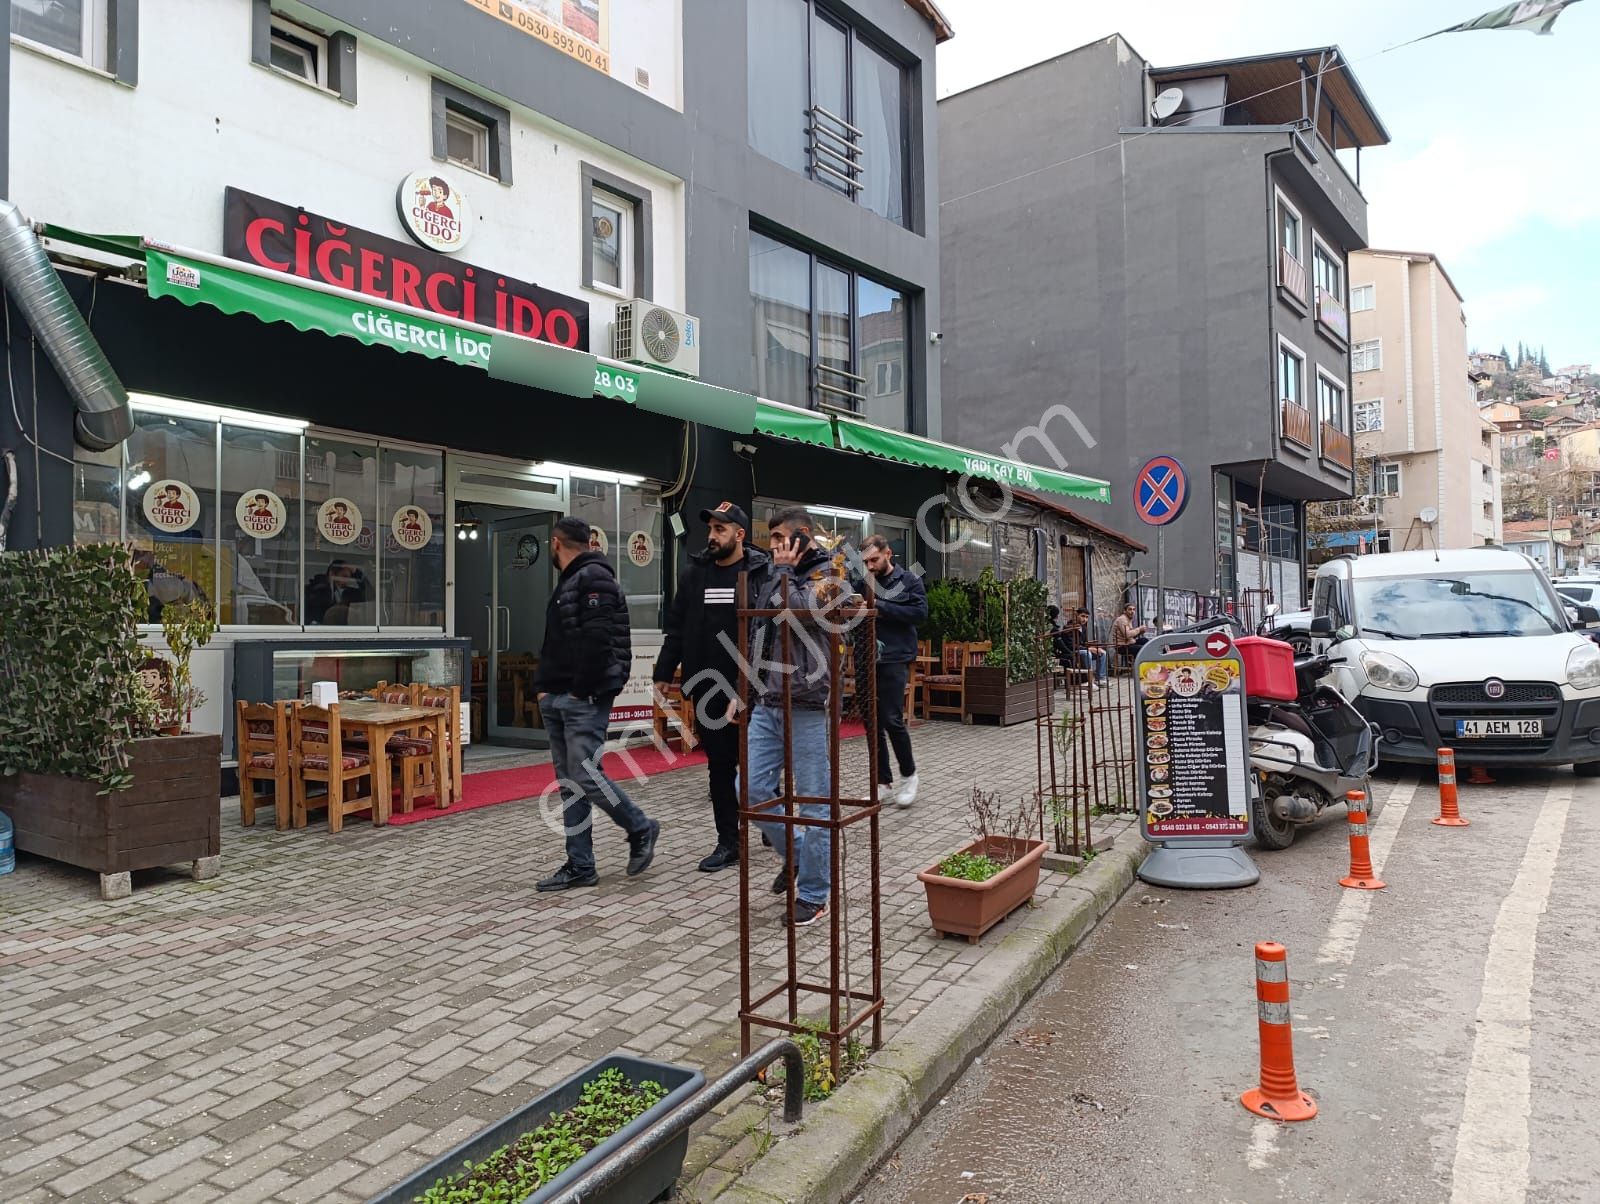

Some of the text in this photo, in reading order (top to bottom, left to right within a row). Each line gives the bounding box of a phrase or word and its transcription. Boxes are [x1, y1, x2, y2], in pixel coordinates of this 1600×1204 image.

[518, 13, 609, 72] 0530 593 00 41
[245, 214, 579, 349] CİĞERCİ İDO
[351, 310, 447, 351] CİĞERCİ
[615, 375, 635, 393] 03
[684, 319, 692, 346] beko
[963, 457, 991, 474] VADİ
[993, 464, 1013, 479] ÇAY
[1465, 721, 1539, 734] 41 AEM 128
